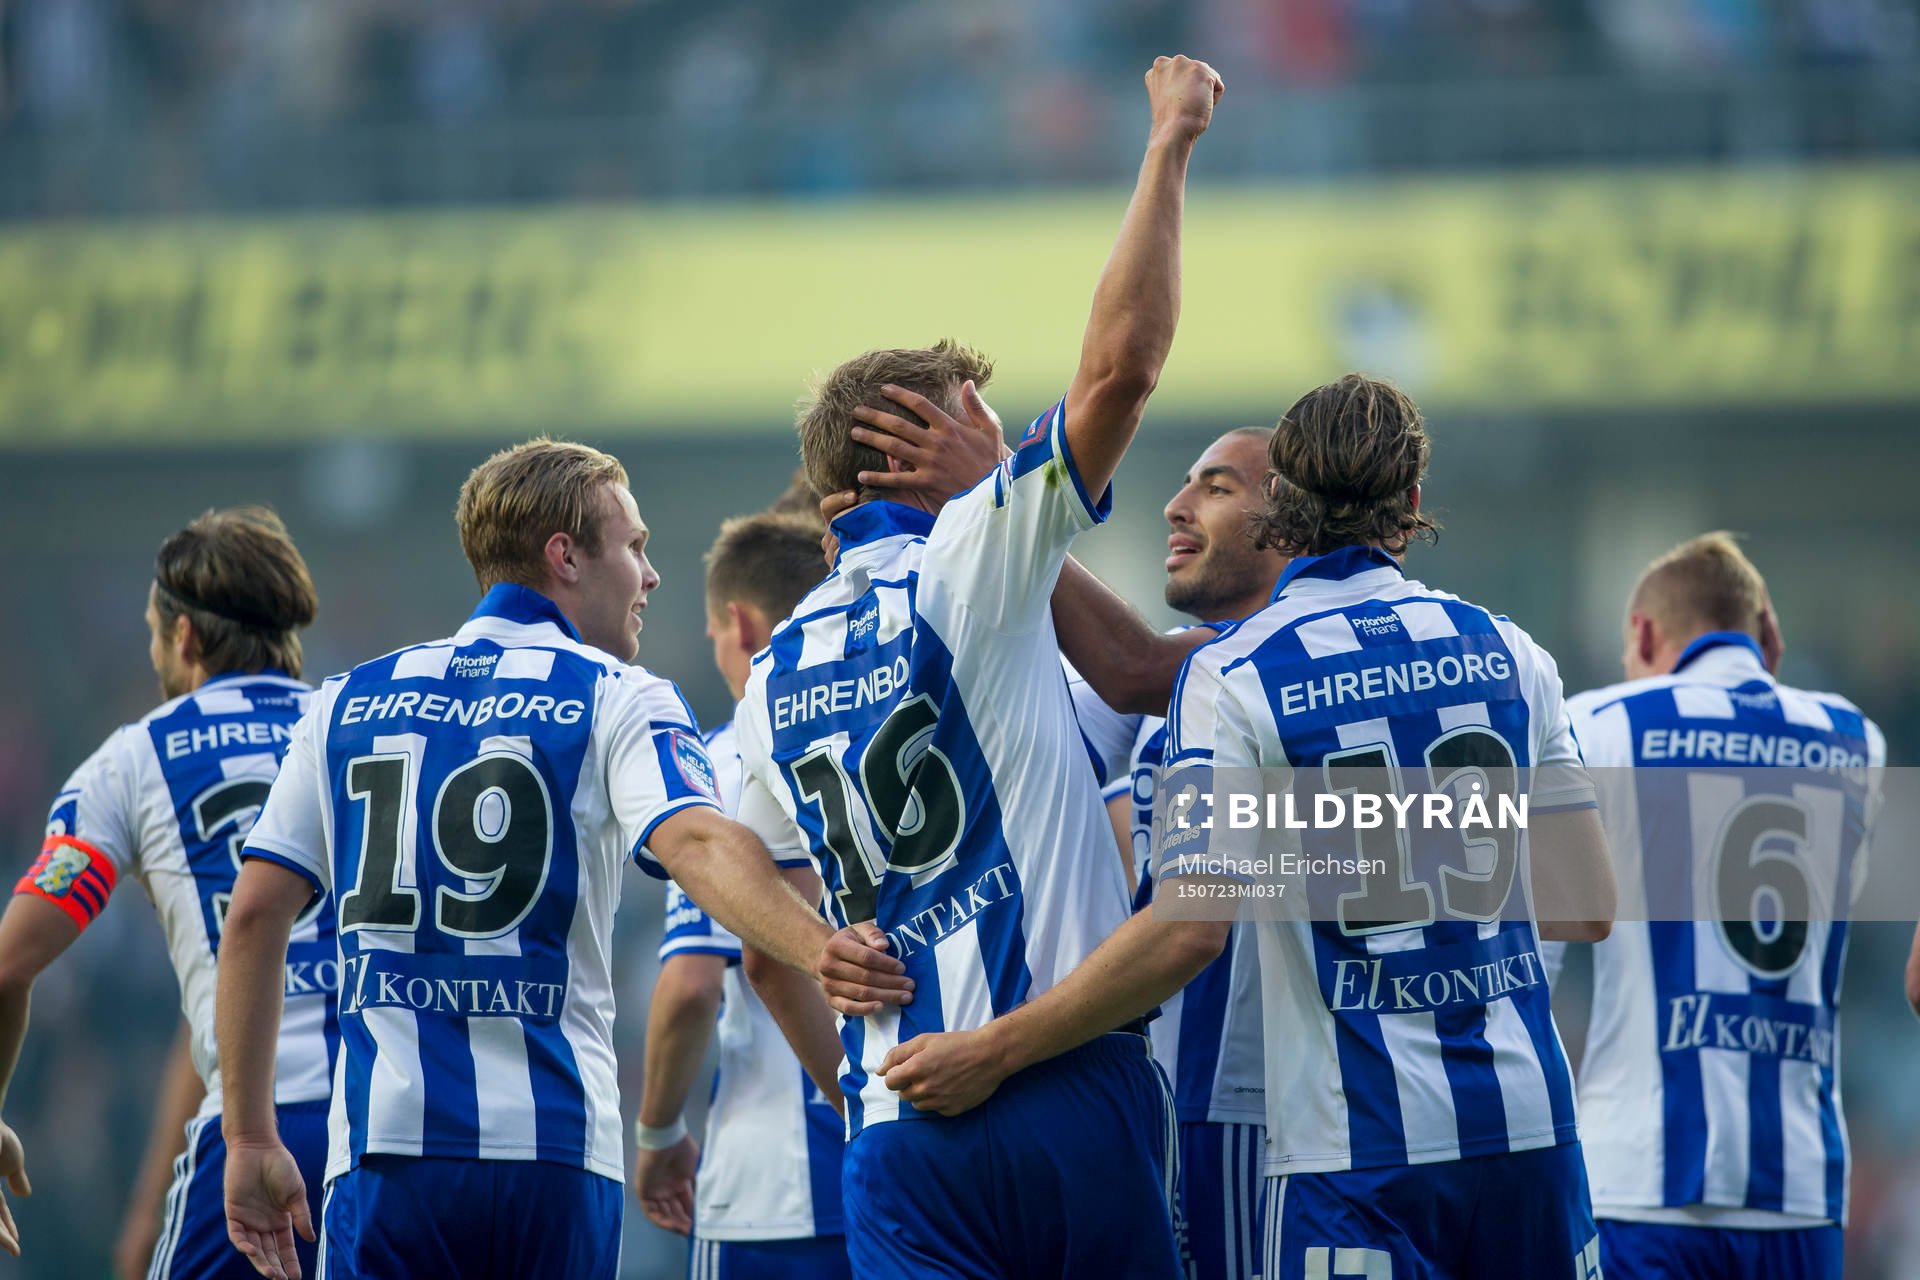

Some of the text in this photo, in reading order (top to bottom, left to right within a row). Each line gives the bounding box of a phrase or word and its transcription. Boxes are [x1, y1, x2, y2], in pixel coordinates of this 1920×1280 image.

[1351, 612, 1400, 629] Prioritet
[1363, 623, 1399, 637] Finans
[450, 654, 498, 668] Prioritet
[455, 666, 490, 678] Finans
[1280, 652, 1511, 717] EHRENBORG
[339, 691, 585, 728] EHRENBORG
[1641, 729, 1867, 787] EHRENBORG
[789, 691, 967, 927] 16
[1322, 724, 1519, 938] 13
[338, 749, 555, 940] 19
[1714, 792, 1813, 981] 6
[375, 971, 563, 1017] KONTAKT
[1329, 951, 1541, 1012] El KONTAKT
[1662, 994, 1711, 1052] El
